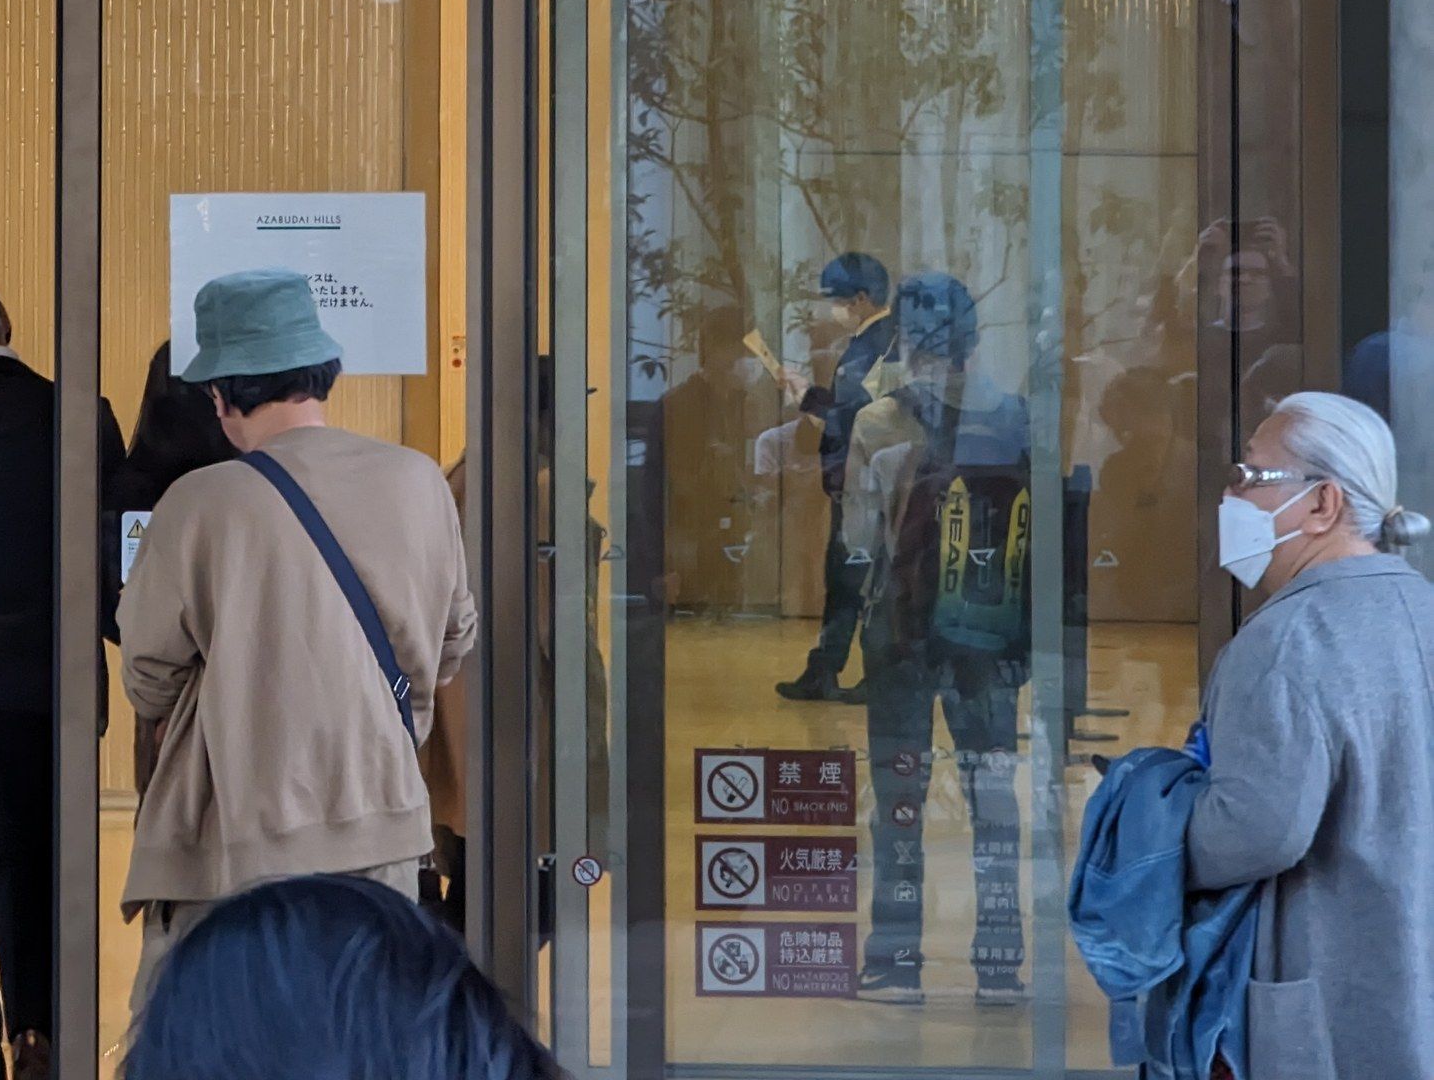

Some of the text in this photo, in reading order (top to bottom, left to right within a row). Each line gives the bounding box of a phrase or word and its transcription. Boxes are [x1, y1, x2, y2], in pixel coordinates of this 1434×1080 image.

[256, 215, 342, 224] AZABUDAI HILLS
[314, 298, 373, 308] だけません。
[946, 491, 963, 592] HEAD
[772, 798, 848, 814] NO SMOKING
[780, 848, 842, 871] 火気厳禁
[773, 884, 790, 902] NO
[780, 931, 842, 947] 危険物品
[780, 948, 842, 963] 持込厳禁
[772, 973, 790, 990] NO
